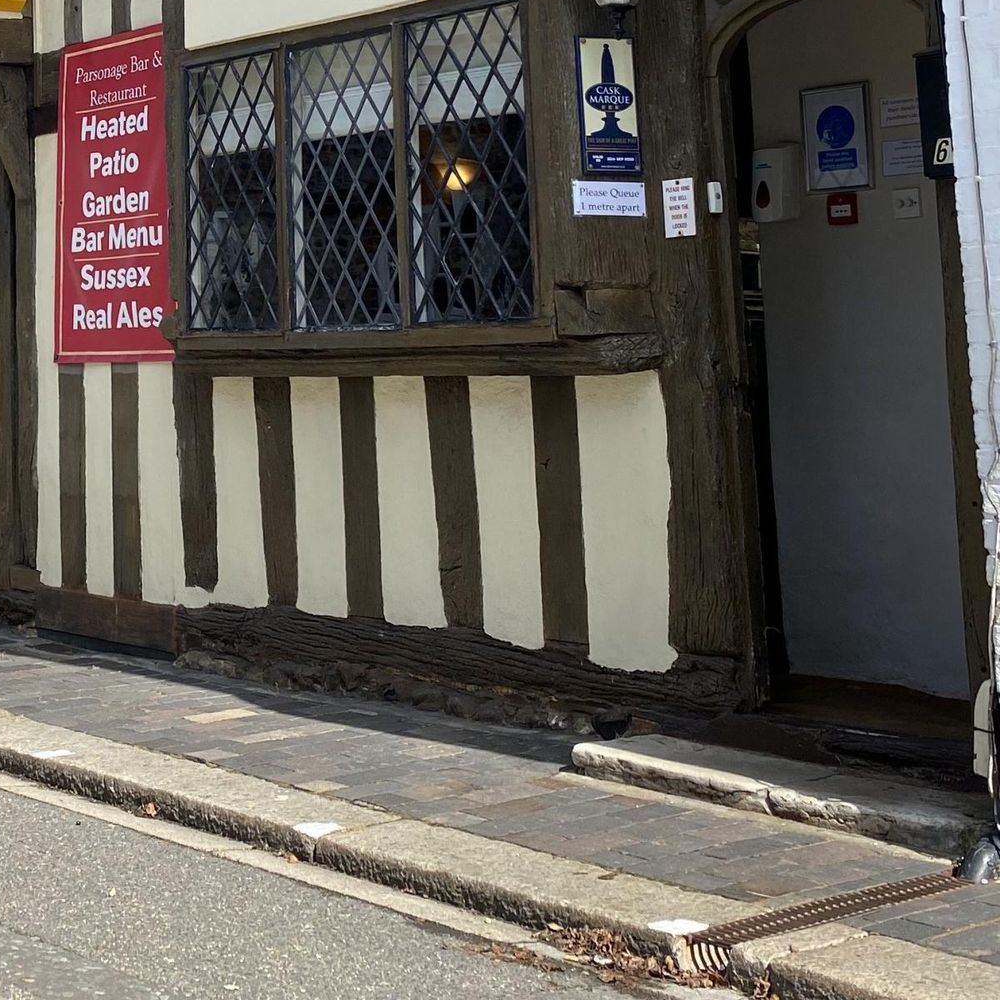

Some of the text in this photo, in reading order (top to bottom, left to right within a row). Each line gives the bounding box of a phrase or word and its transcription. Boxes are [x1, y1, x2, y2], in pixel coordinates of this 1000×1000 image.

[75, 50, 163, 84] Parsonage Bar &
[90, 84, 147, 106] Restaurant
[589, 95, 631, 104] MARQUE
[596, 86, 620, 95] CASK
[81, 105, 148, 141] Heated
[90, 148, 139, 178] Patio
[936, 140, 949, 162] 6
[83, 187, 149, 218] Garden
[580, 187, 640, 199] Please Queue
[588, 203, 614, 211] metre
[617, 203, 640, 214] apart
[71, 222, 163, 253] Bar Menu
[80, 264, 151, 291] Sussex
[73, 301, 164, 330] Real Ales
